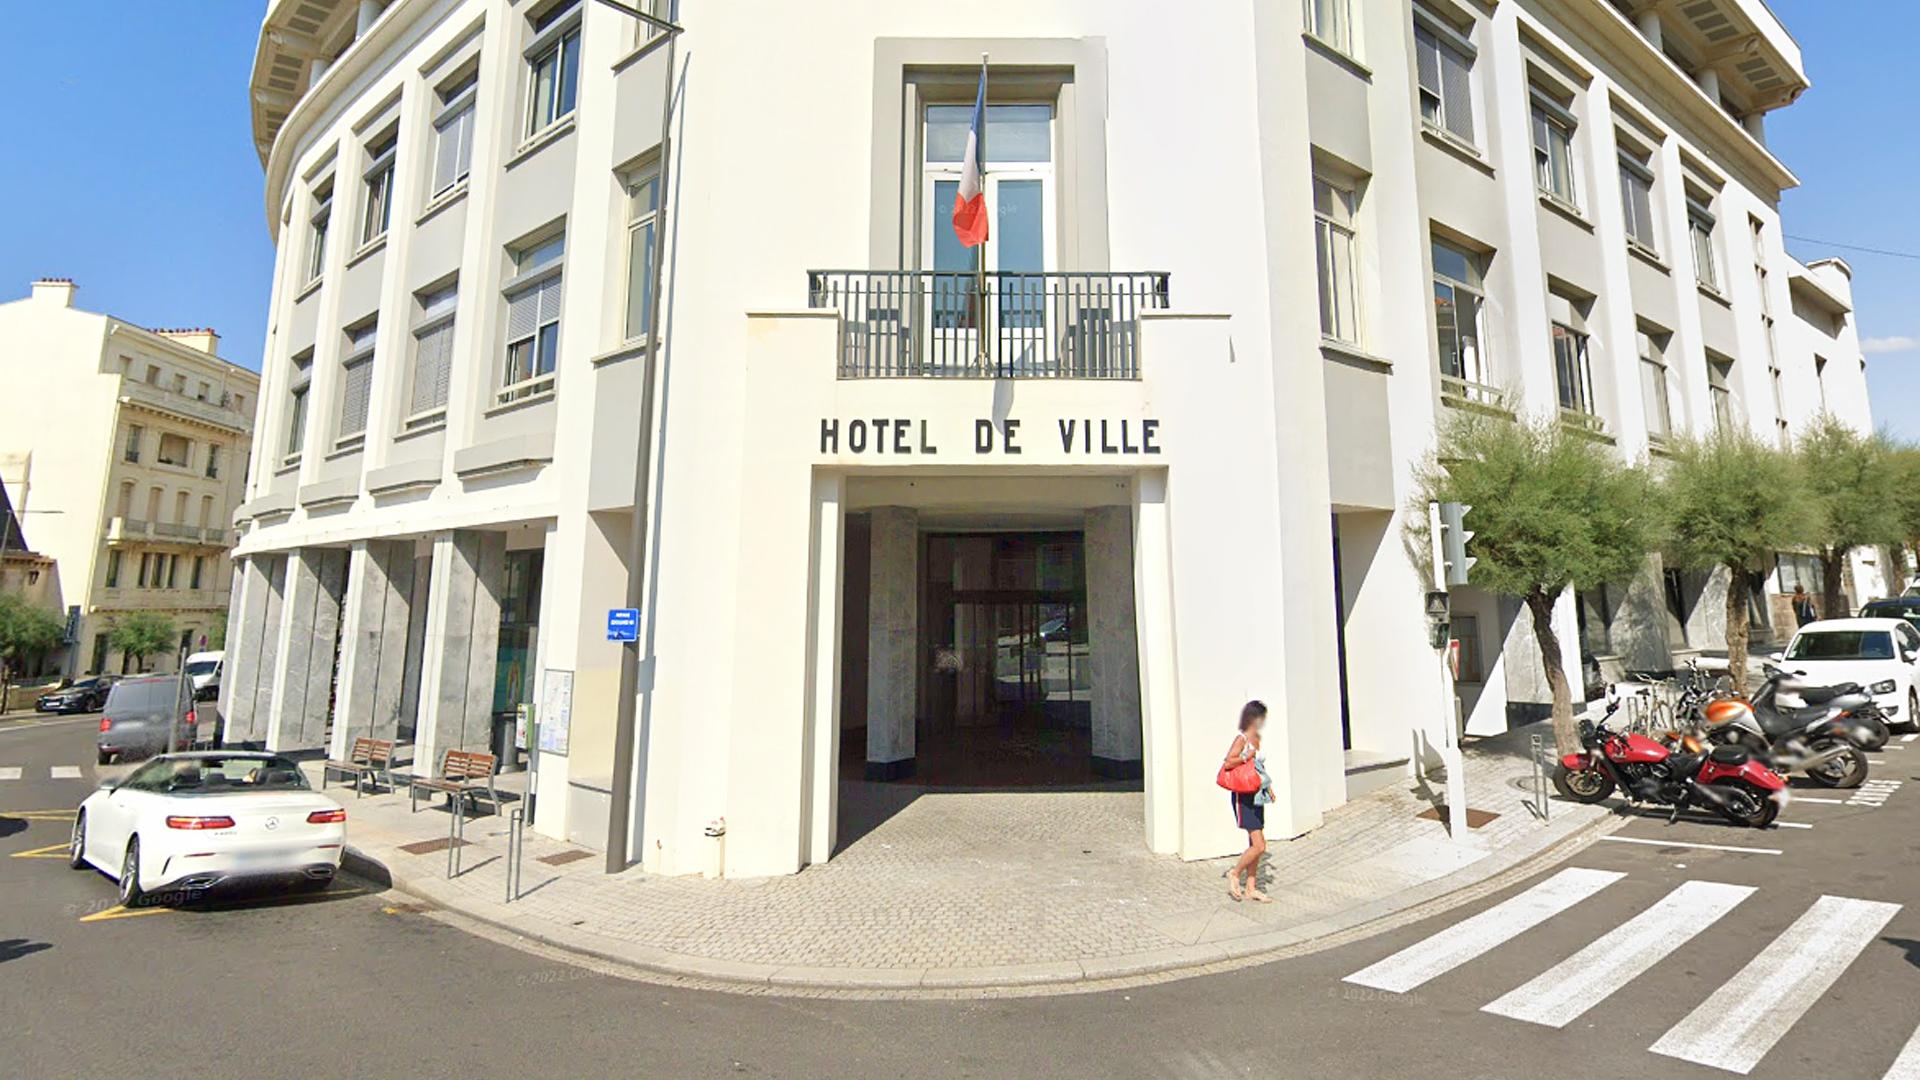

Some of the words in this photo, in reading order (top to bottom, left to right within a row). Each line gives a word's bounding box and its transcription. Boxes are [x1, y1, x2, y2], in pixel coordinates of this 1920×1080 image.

[820, 419, 938, 454] HOTEL
[974, 419, 1023, 454] DE
[1058, 419, 1162, 454] VILLE
